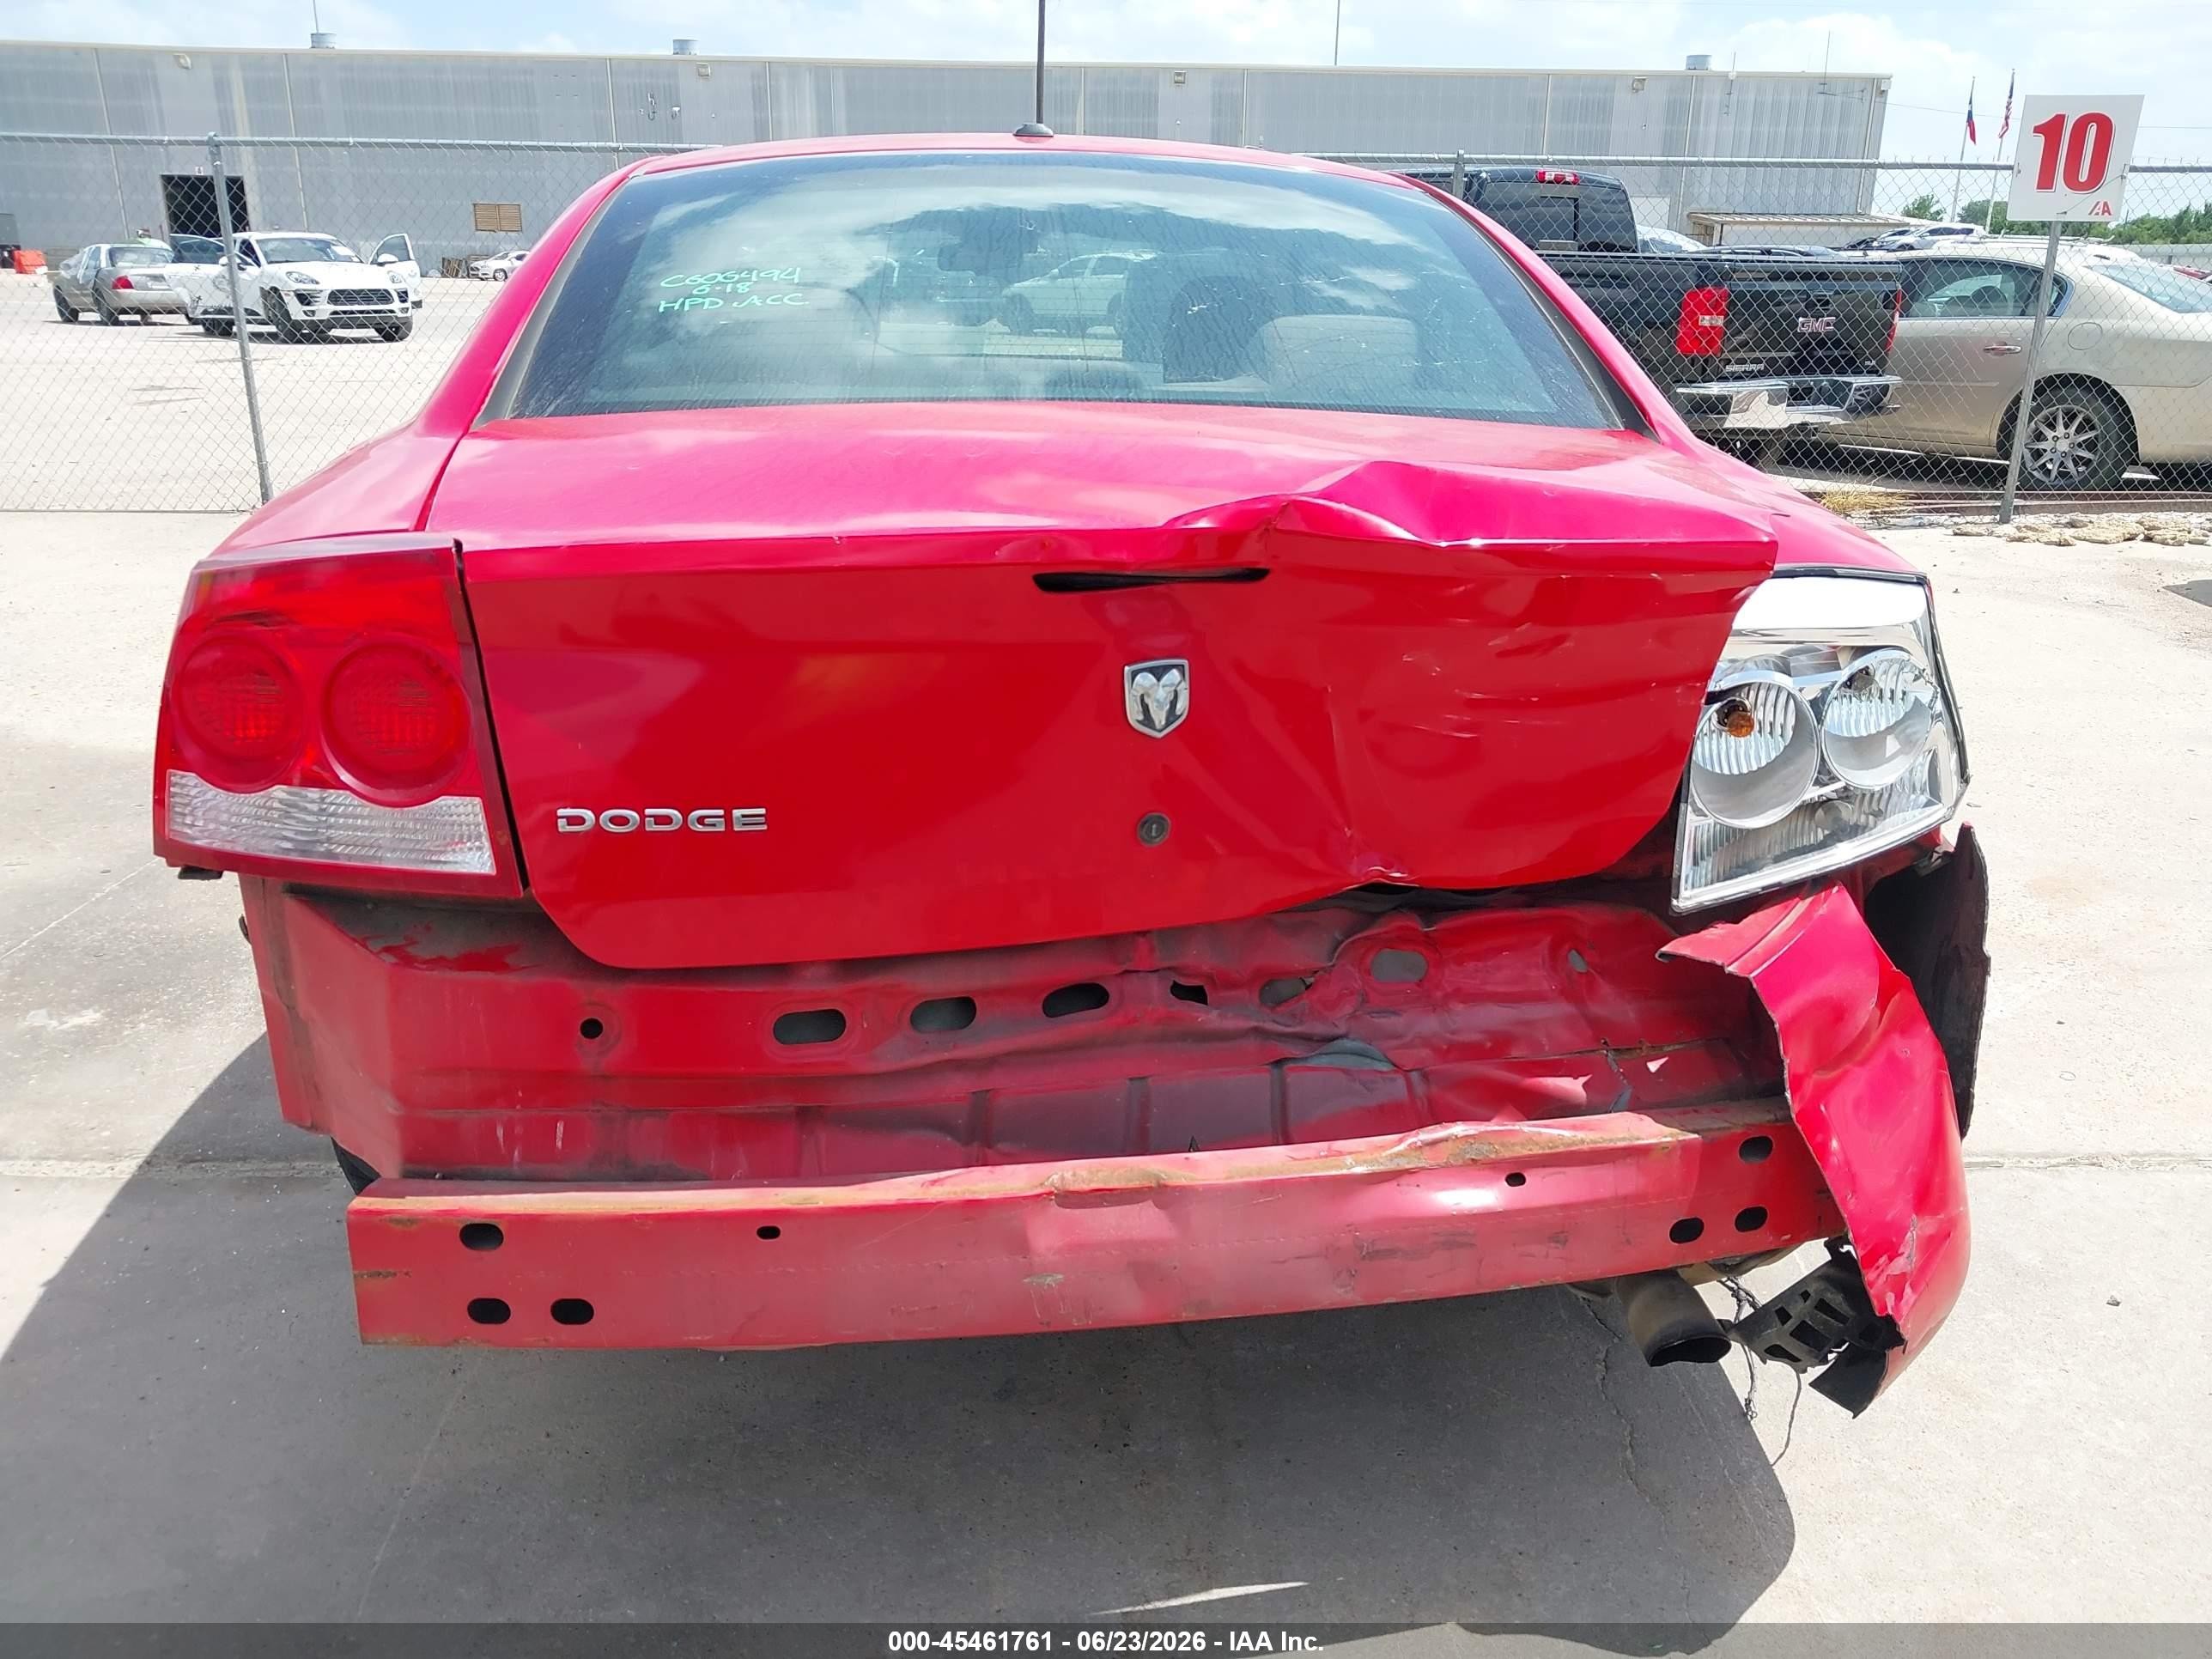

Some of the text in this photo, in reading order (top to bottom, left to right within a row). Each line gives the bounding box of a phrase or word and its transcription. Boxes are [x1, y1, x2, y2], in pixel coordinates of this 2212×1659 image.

[2033, 112, 2116, 193] 10
[659, 297, 724, 313] HPD
[1797, 317, 1836, 332] GMC
[556, 808, 768, 832] DODGE
